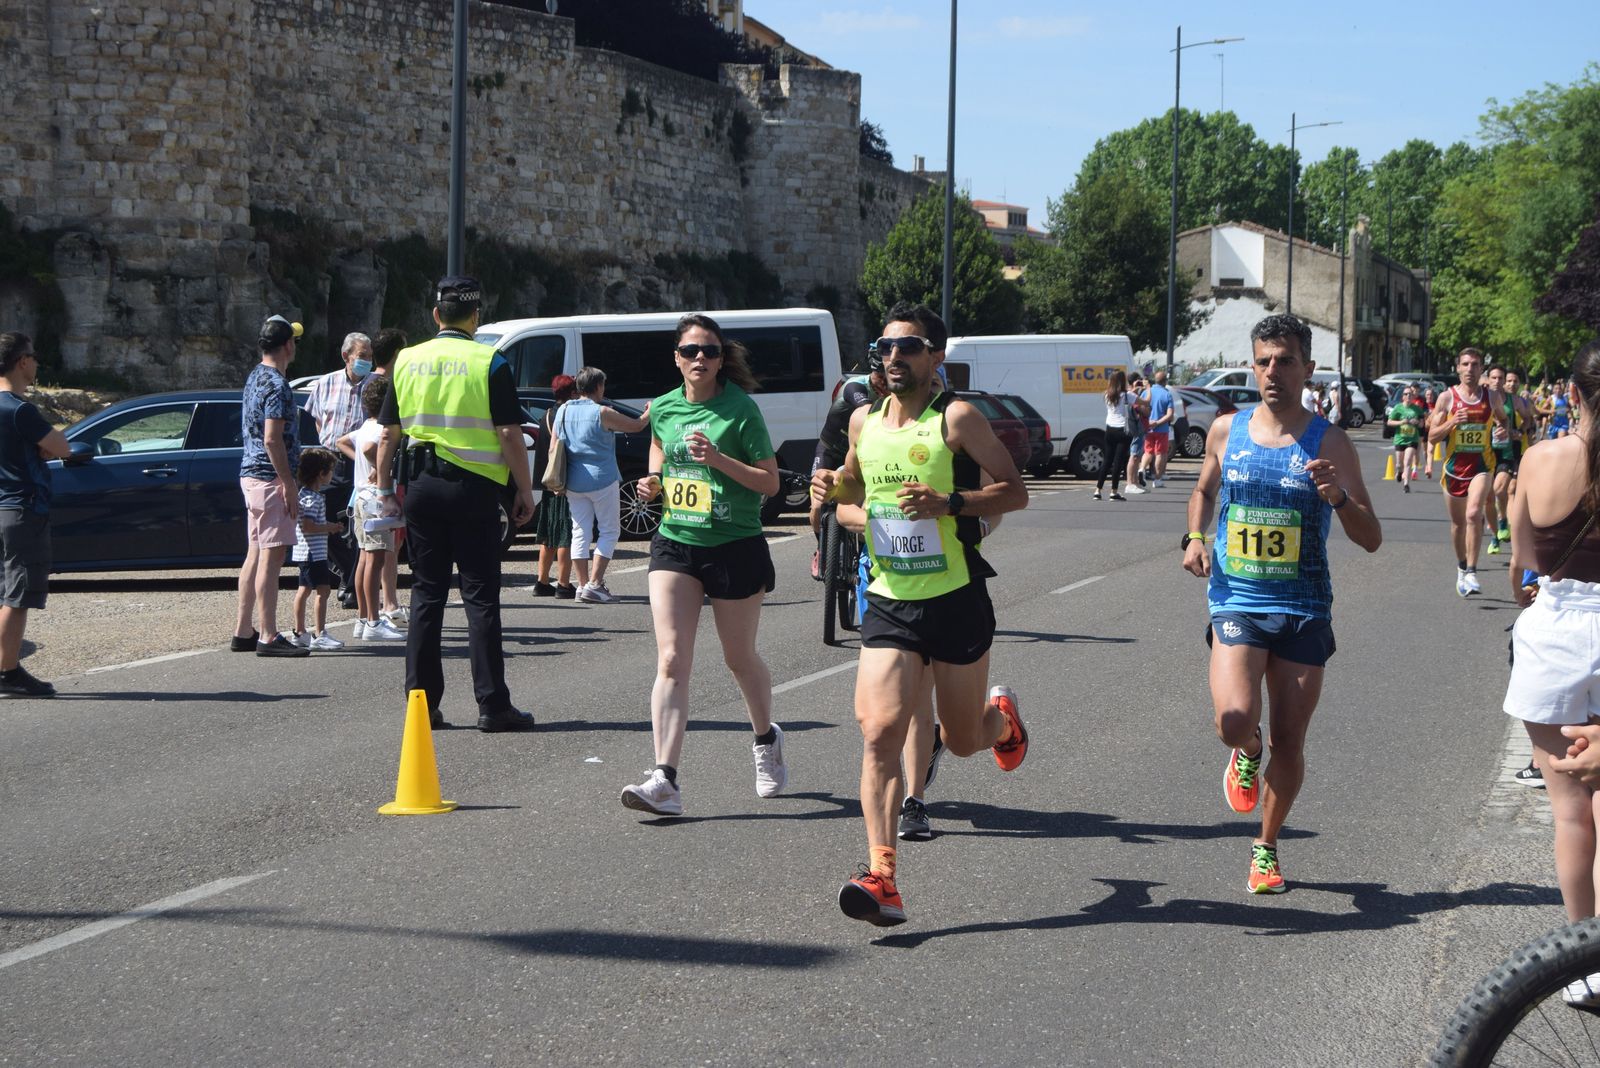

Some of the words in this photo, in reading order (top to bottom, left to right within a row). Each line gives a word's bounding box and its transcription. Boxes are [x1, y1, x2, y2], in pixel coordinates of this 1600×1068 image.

[1459, 432, 1482, 444] 182
[885, 463, 902, 472] C.A.
[872, 476, 882, 484] LA
[672, 482, 698, 507] 86
[890, 535, 925, 555] JORGE
[1237, 527, 1285, 558] 113
[892, 561, 911, 570] CAJA
[912, 560, 943, 569] RURAL
[1244, 564, 1263, 574] CAJA
[1265, 566, 1294, 574] RURAL
